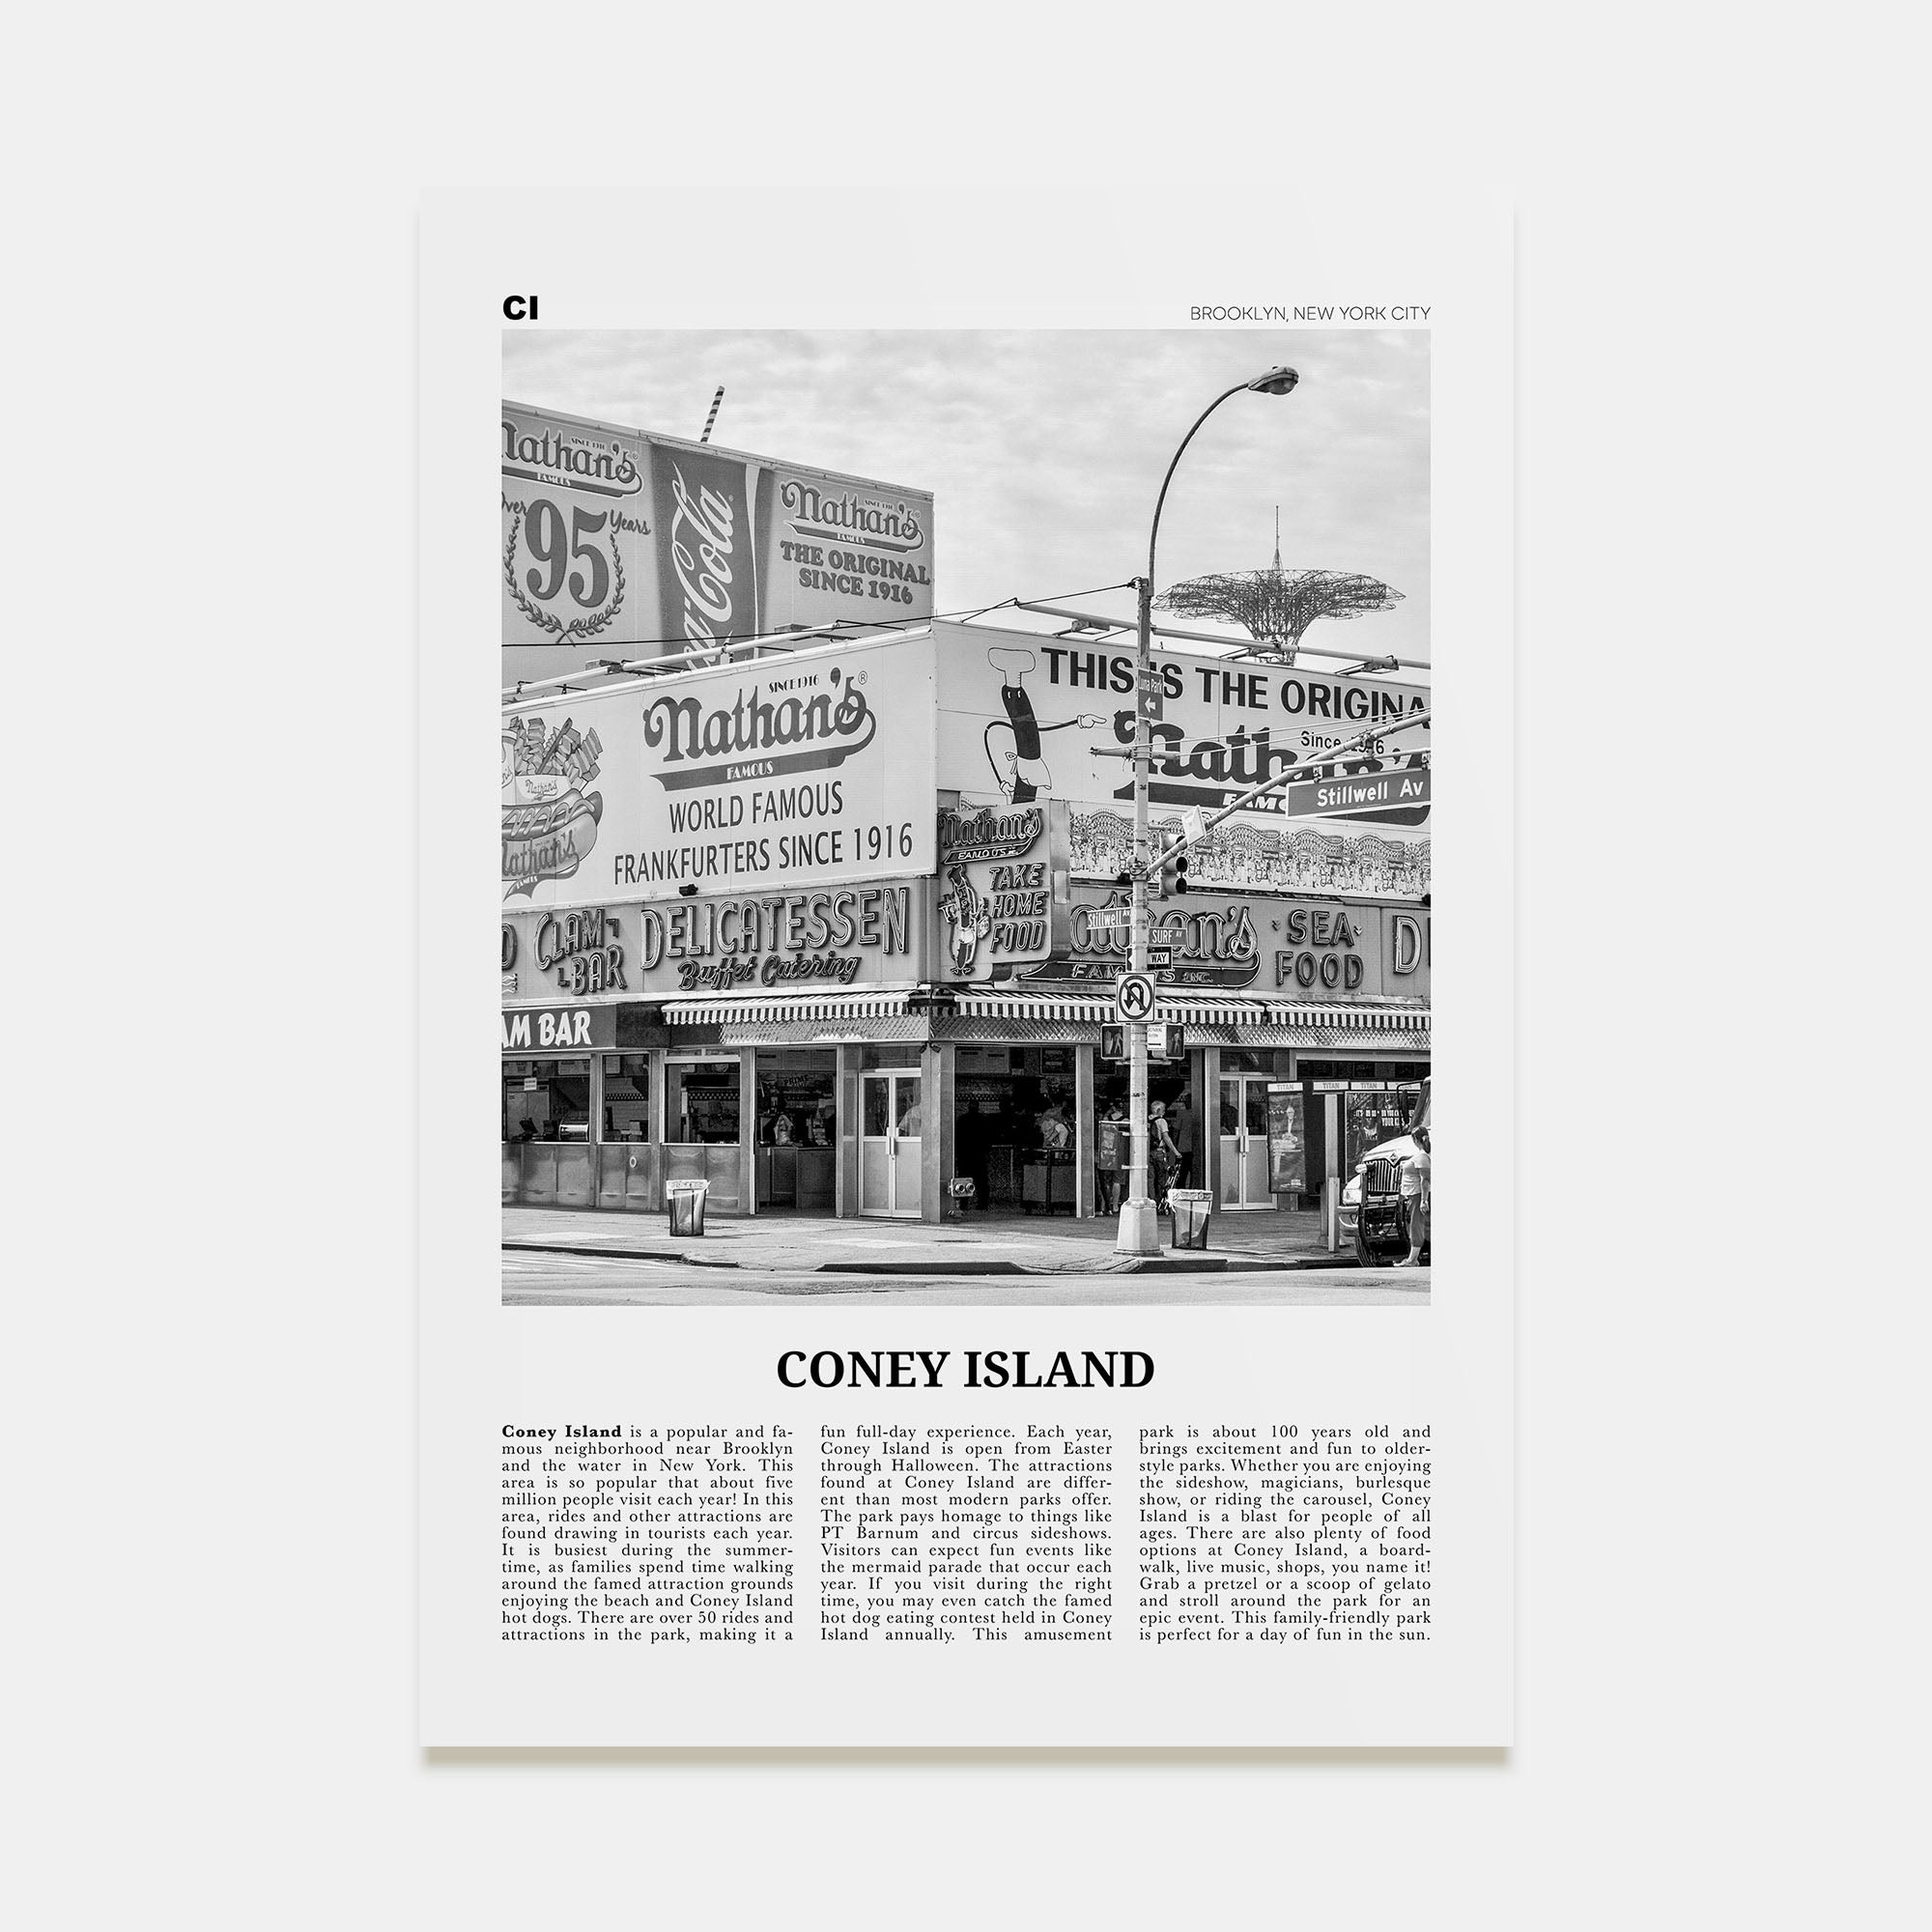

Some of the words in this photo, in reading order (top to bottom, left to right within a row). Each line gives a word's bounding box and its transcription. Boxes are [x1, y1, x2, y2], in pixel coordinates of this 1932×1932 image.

[502, 295, 538, 321] CI
[1191, 306, 1290, 323] BROOKLYN,
[1293, 306, 1335, 321] NEW
[1339, 306, 1387, 321] YORK
[1391, 306, 1432, 321] CITY
[502, 492, 528, 516] ver
[780, 481, 921, 541] Nathan's
[610, 509, 652, 535] Years
[525, 498, 610, 609] 95
[780, 540, 825, 568] THE
[828, 549, 931, 585] ORIGINAL
[799, 567, 865, 597] SINCE
[868, 581, 914, 606] 1916
[769, 678, 796, 694] SINCE
[797, 673, 820, 690] 1916
[1041, 647, 1135, 695] THIS
[1195, 667, 1269, 711] THE
[642, 667, 867, 763] Nathan's
[726, 761, 774, 781] FAMOUS
[1317, 781, 1389, 808] Stillwell
[1400, 779, 1424, 798] Av
[669, 795, 744, 833] WORLD
[753, 781, 844, 823] FAMOUS
[613, 838, 771, 885] FRANKFURTERS
[779, 831, 844, 869] SINCE
[854, 822, 913, 862] 1916
[989, 862, 1046, 892] TAKE
[990, 891, 1050, 919] HOME
[640, 887, 911, 971] DELICATESSEN
[1088, 911, 1122, 927] Stillwell
[1287, 908, 1355, 948] SEA
[533, 908, 606, 972] CLAM
[988, 920, 1048, 954] FOOD
[1151, 929, 1174, 944] SURF
[570, 944, 628, 996] BAR
[678, 953, 755, 991] Buffet
[761, 951, 863, 988] Catering
[1151, 953, 1167, 964] WAY
[1275, 950, 1364, 989] FOOD
[537, 1010, 592, 1046] BAR
[777, 1350, 952, 1389] CONEY
[963, 1350, 1155, 1389] ISLAND
[501, 1425, 556, 1441] Coney
[564, 1425, 622, 1437] Island
[630, 1425, 641, 1437] is
[649, 1429, 658, 1437] a
[666, 1425, 727, 1441] popular
[735, 1425, 763, 1437] and
[772, 1425, 792, 1437] fa-
[820, 1425, 845, 1437] fun
[856, 1425, 916, 1441] full-day
[926, 1425, 1014, 1441] experience.
[1027, 1425, 1065, 1437] Each
[1074, 1429, 1111, 1441] year,
[1139, 1425, 1174, 1441] park
[1186, 1425, 1199, 1437] is
[1212, 1425, 1256, 1437] about
[1271, 1425, 1297, 1437] 100
[1311, 1429, 1350, 1441] years
[1364, 1425, 1388, 1437] old
[1402, 1425, 1431, 1437] and
[501, 1445, 542, 1455] mous
[554, 1441, 663, 1459] neighborhood
[675, 1445, 710, 1455] near
[723, 1441, 792, 1459] Brooklyn
[820, 1459, 881, 1475] through
[891, 1459, 978, 1471] Halloween.
[987, 1459, 1019, 1471] The
[1028, 1459, 1112, 1471] attractions
[501, 1479, 534, 1488] area
[546, 1475, 557, 1488] is
[568, 1479, 584, 1488] so
[595, 1475, 657, 1492] popular
[668, 1475, 698, 1488] that
[710, 1475, 753, 1488] about
[765, 1475, 792, 1488] five
[1139, 1475, 1163, 1488] the
[1176, 1475, 1248, 1491] sideshow,
[1261, 1475, 1343, 1492] magicians,
[1355, 1475, 1431, 1492] burlesque
[1139, 1509, 1186, 1521] Island
[1198, 1509, 1209, 1521] is
[1221, 1513, 1229, 1521] a
[1240, 1509, 1277, 1521] blast
[1288, 1509, 1310, 1521] for
[1321, 1509, 1372, 1525] people
[1383, 1509, 1401, 1521] of
[1411, 1509, 1430, 1521] all
[501, 1525, 546, 1539] found
[554, 1525, 617, 1543] drawing
[625, 1525, 639, 1539] in
[648, 1525, 705, 1539] tourists
[713, 1525, 748, 1539] each
[756, 1529, 792, 1543] year.
[820, 1525, 843, 1539] PT
[856, 1525, 918, 1539] Barnum
[931, 1525, 959, 1539] and
[973, 1525, 1018, 1539] circus
[1031, 1525, 1111, 1539] sideshows.
[1139, 1559, 1179, 1575] walk,
[1186, 1559, 1213, 1573] live
[1220, 1559, 1269, 1575] music,
[1276, 1559, 1324, 1577] shops,
[1331, 1563, 1358, 1577] you
[1366, 1563, 1407, 1573] name
[1414, 1559, 1430, 1573] it!
[501, 1627, 584, 1640] attractions
[593, 1627, 608, 1640] in
[617, 1627, 641, 1640] the
[650, 1627, 690, 1644] park,
[698, 1627, 756, 1644] making
[764, 1627, 776, 1640] it
[784, 1631, 793, 1640] a
[820, 1627, 868, 1640] Island
[885, 1627, 954, 1644] annually.
[975, 1627, 1007, 1640] This
[1024, 1629, 1112, 1640] amusement
